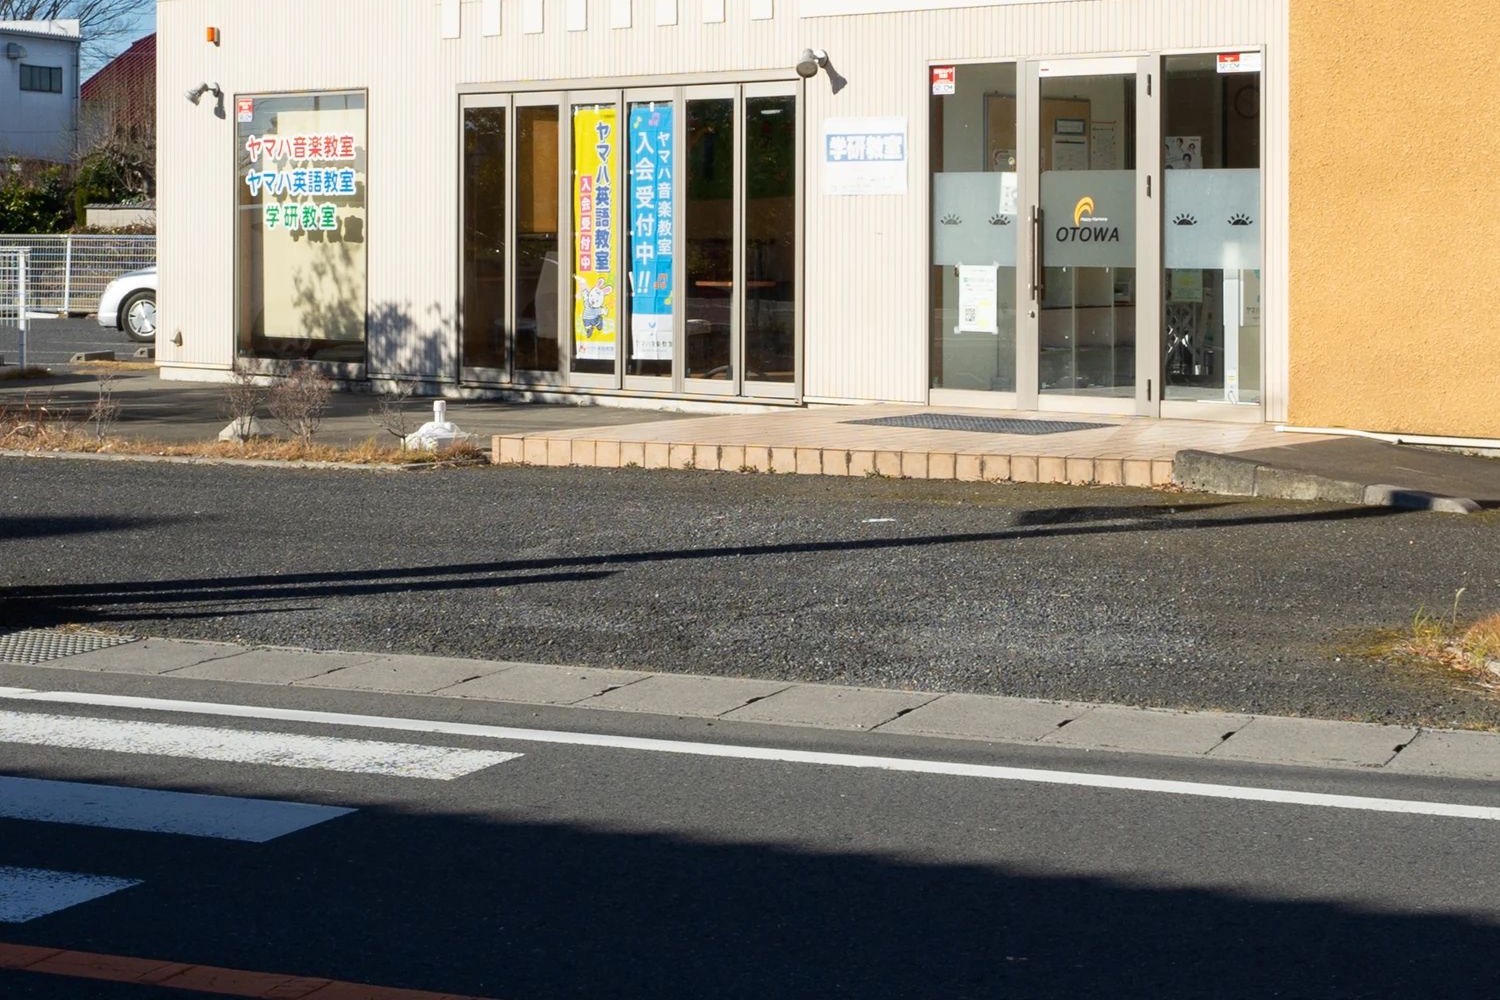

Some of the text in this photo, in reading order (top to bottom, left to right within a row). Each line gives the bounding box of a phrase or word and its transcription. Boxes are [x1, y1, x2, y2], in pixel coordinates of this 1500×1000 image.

[247, 135, 355, 160] ヤマハ音楽教室
[247, 169, 355, 193] ヤマハ英語教室
[657, 131, 673, 255] ヤマハ音楽教室
[595, 122, 611, 271] ヤマハ英語教室
[266, 205, 335, 228] 学研教室
[580, 177, 592, 270] 入会受付中
[1056, 227, 1120, 242] OTOWA
